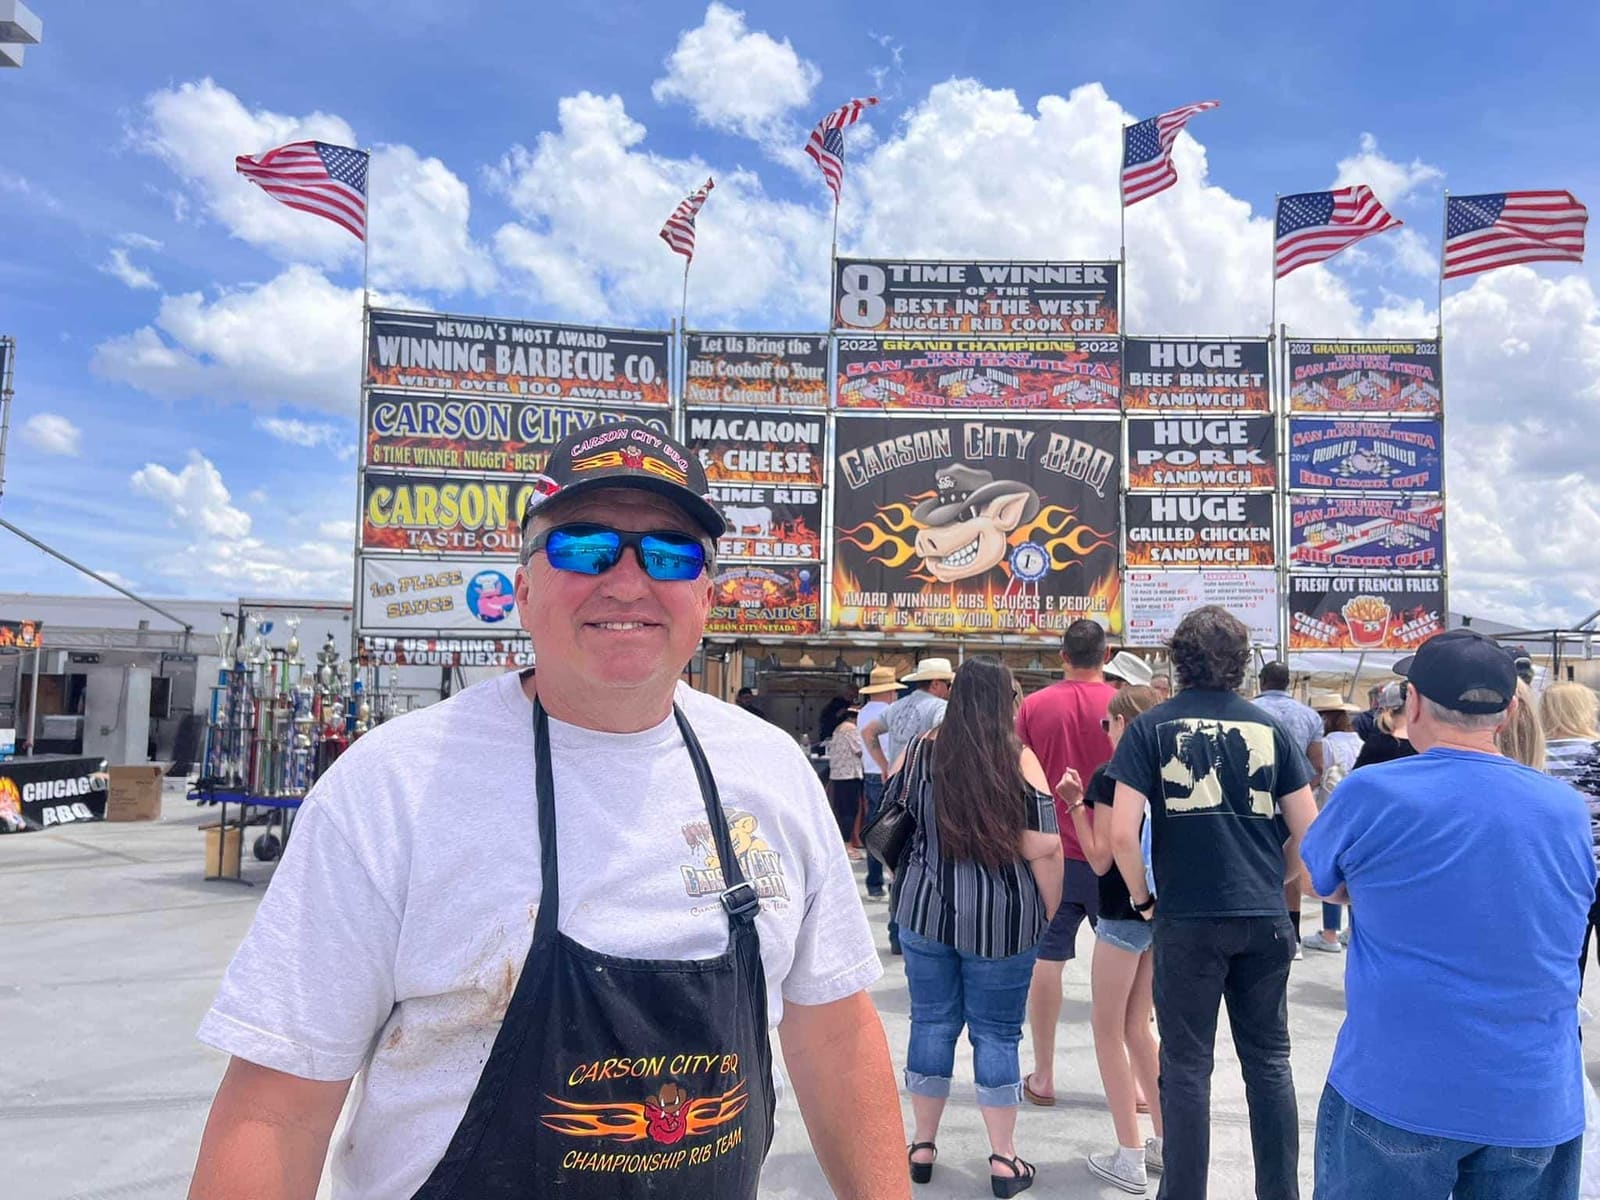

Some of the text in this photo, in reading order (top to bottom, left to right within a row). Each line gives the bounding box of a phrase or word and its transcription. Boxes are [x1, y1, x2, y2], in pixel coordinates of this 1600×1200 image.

[839, 264, 1108, 327] 8 TIME WINNER
[966, 287, 1029, 296] OF THE
[894, 298, 1100, 315] BEST IN THE WEST
[436, 321, 607, 349] NEVADA'S MOST AWARD
[889, 317, 1105, 332] NUGGET RIB COOK OFF
[700, 336, 812, 358] Let Us Bring the
[840, 340, 1119, 353] 2022 GRAND CHAMPIONS 2022
[1150, 343, 1242, 368] HUGE
[1312, 344, 1350, 354] GRAND
[1351, 344, 1415, 354] CHAMPIONS
[377, 335, 662, 386] WINNING BARBECUE CO.
[689, 360, 825, 380] Rib Cookoff to Your
[847, 360, 902, 377] SAN
[398, 374, 643, 401] WITH OVER 100 AWARDS
[1129, 372, 1264, 388] BEEF BRISKET
[689, 384, 721, 401] Next
[1149, 392, 1245, 407] SANDWICH
[372, 401, 511, 442] CARSON
[691, 418, 820, 444] MACARONI
[571, 429, 628, 457] CARSON
[631, 429, 662, 448] CITY
[1154, 421, 1248, 445] HUGE
[383, 445, 411, 465] TIME
[464, 450, 507, 470] NUGGET
[723, 449, 811, 474] CHEESE
[839, 422, 1115, 498] CARSON CITY BBQ
[1137, 450, 1266, 465] PORK
[1153, 470, 1251, 484] SANDWICH
[709, 487, 818, 505] RIME RIB
[368, 484, 510, 530] CARSON
[1151, 497, 1247, 522] HUGE
[407, 529, 523, 548] TASTE OU
[1129, 527, 1270, 542] GRILLED CHICKEN
[719, 541, 813, 558] EF RIBS
[1150, 548, 1250, 561] SANDWICH
[398, 570, 463, 592] PLACE
[1295, 577, 1439, 592] FRESH CUT FRENCH FRIES
[386, 596, 454, 618] SAUCE
[711, 603, 817, 620] ST SAUCE
[843, 592, 887, 606] AWARD
[893, 592, 950, 608] WINNING
[993, 595, 1040, 610] SAUCES
[862, 610, 886, 625] LET
[893, 611, 909, 625] US
[913, 611, 954, 626] CATER
[960, 612, 993, 626] YOUR
[997, 613, 1031, 628] NEXT
[1294, 612, 1338, 636] CHEESE
[1393, 610, 1440, 636] GARLIC
[1294, 621, 1330, 643] FRIES
[1401, 621, 1438, 642] FRIES
[363, 637, 534, 653] LET US BRING THE
[405, 651, 455, 665] YOUR
[460, 652, 508, 665] NEXT
[22, 776, 107, 802] CHICAGO
[42, 802, 94, 826] BBQ
[568, 1055, 666, 1086] CARSON
[670, 1054, 720, 1075] CITY
[562, 1126, 743, 1175] CHAMPIONSHIP RIB TEAM
